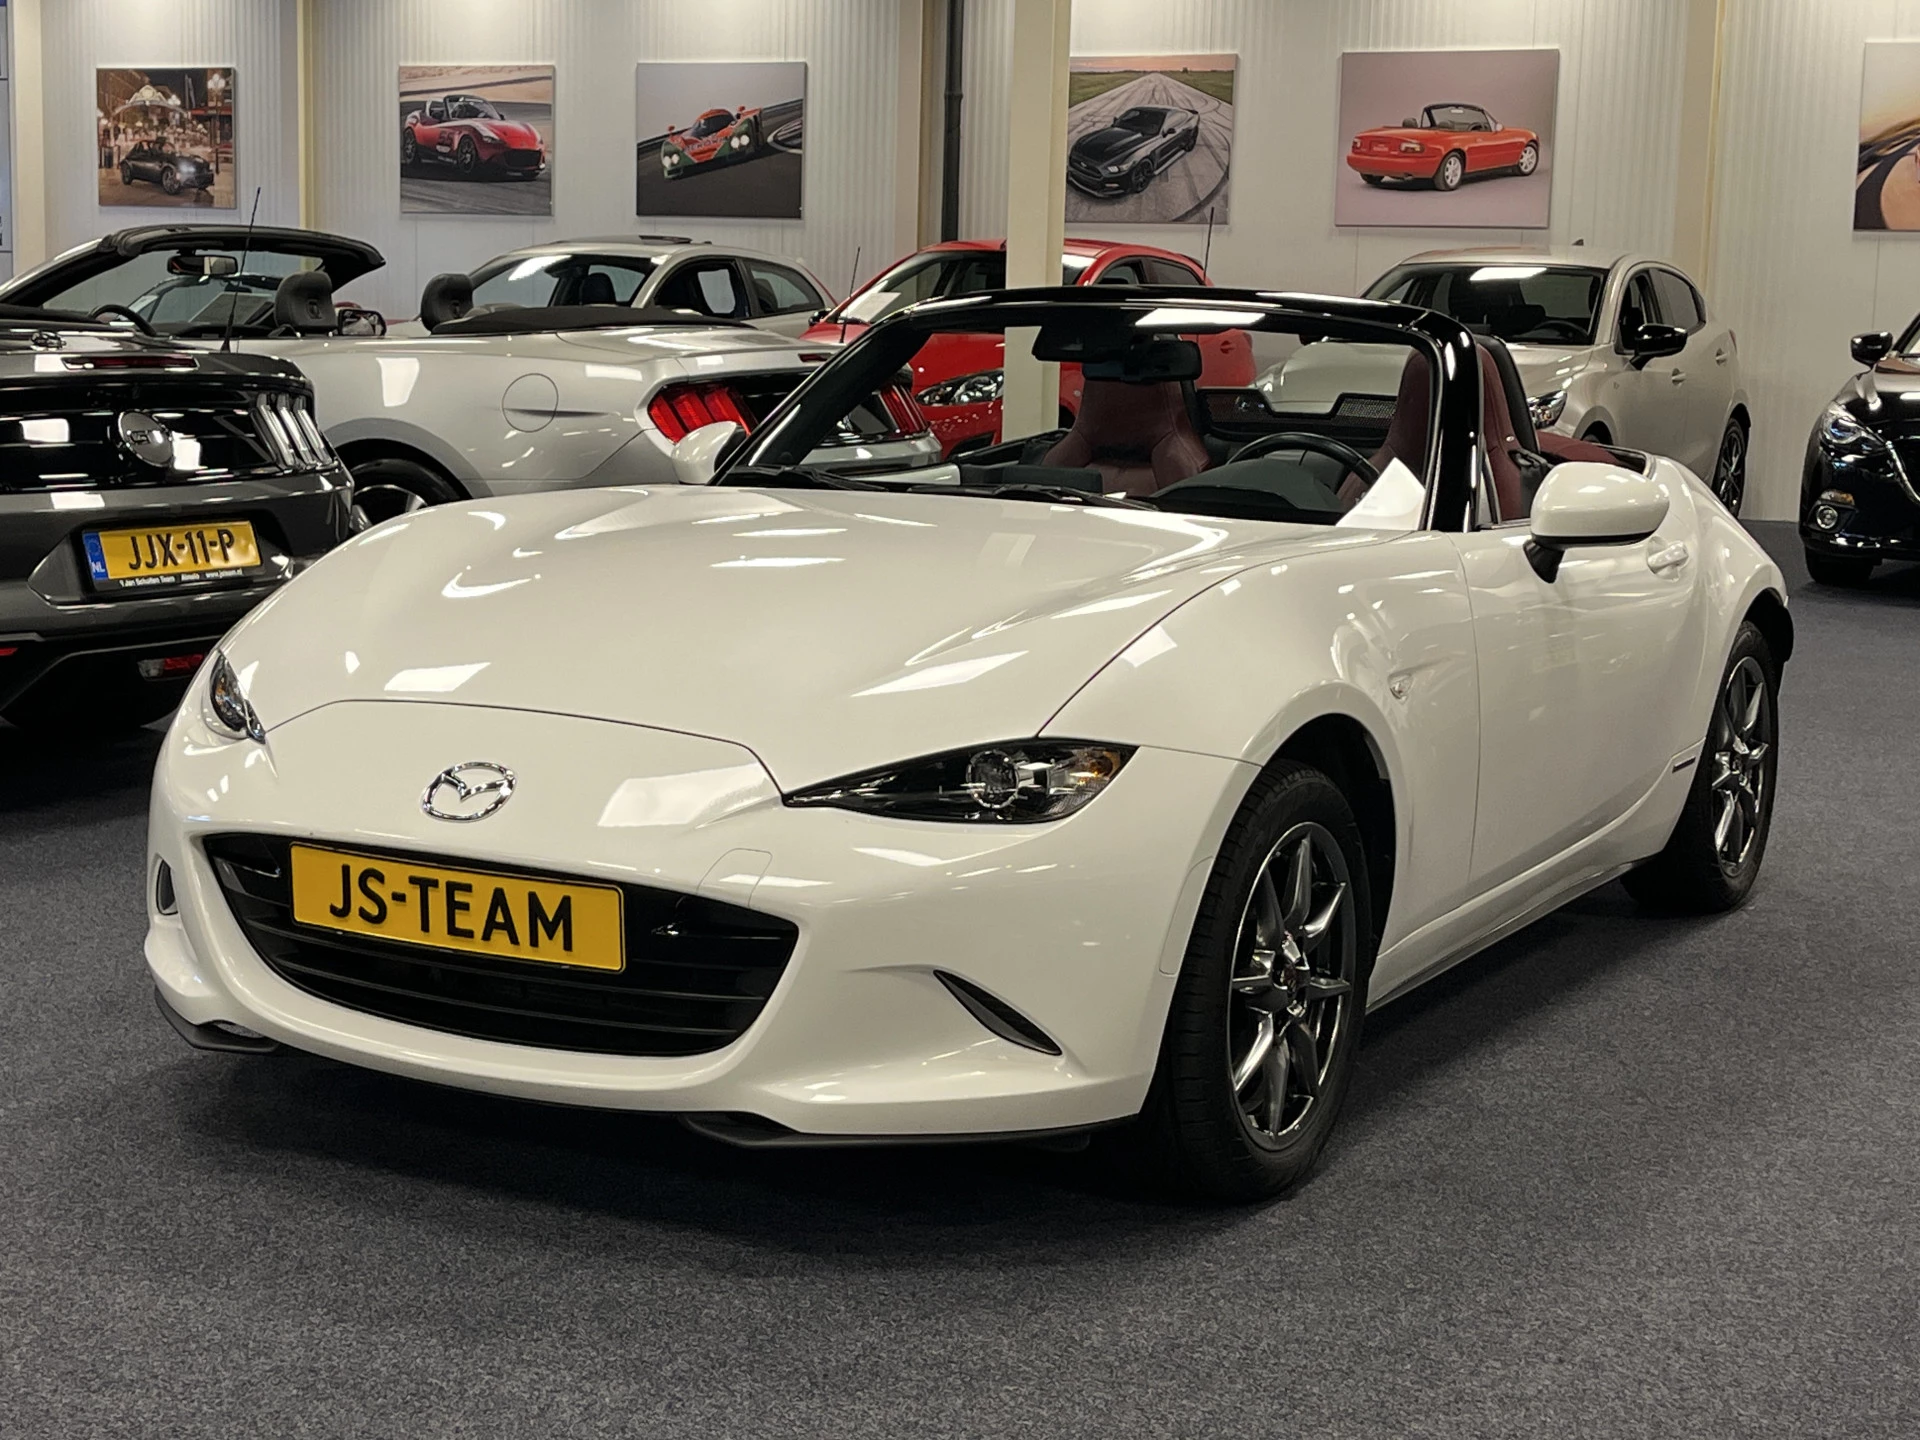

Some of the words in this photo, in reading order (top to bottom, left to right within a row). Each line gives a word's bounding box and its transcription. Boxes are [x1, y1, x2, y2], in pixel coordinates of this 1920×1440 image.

[91, 561, 105, 573] NL
[129, 529, 235, 570] JJX-11-P
[329, 864, 573, 952] JS-TEAM
